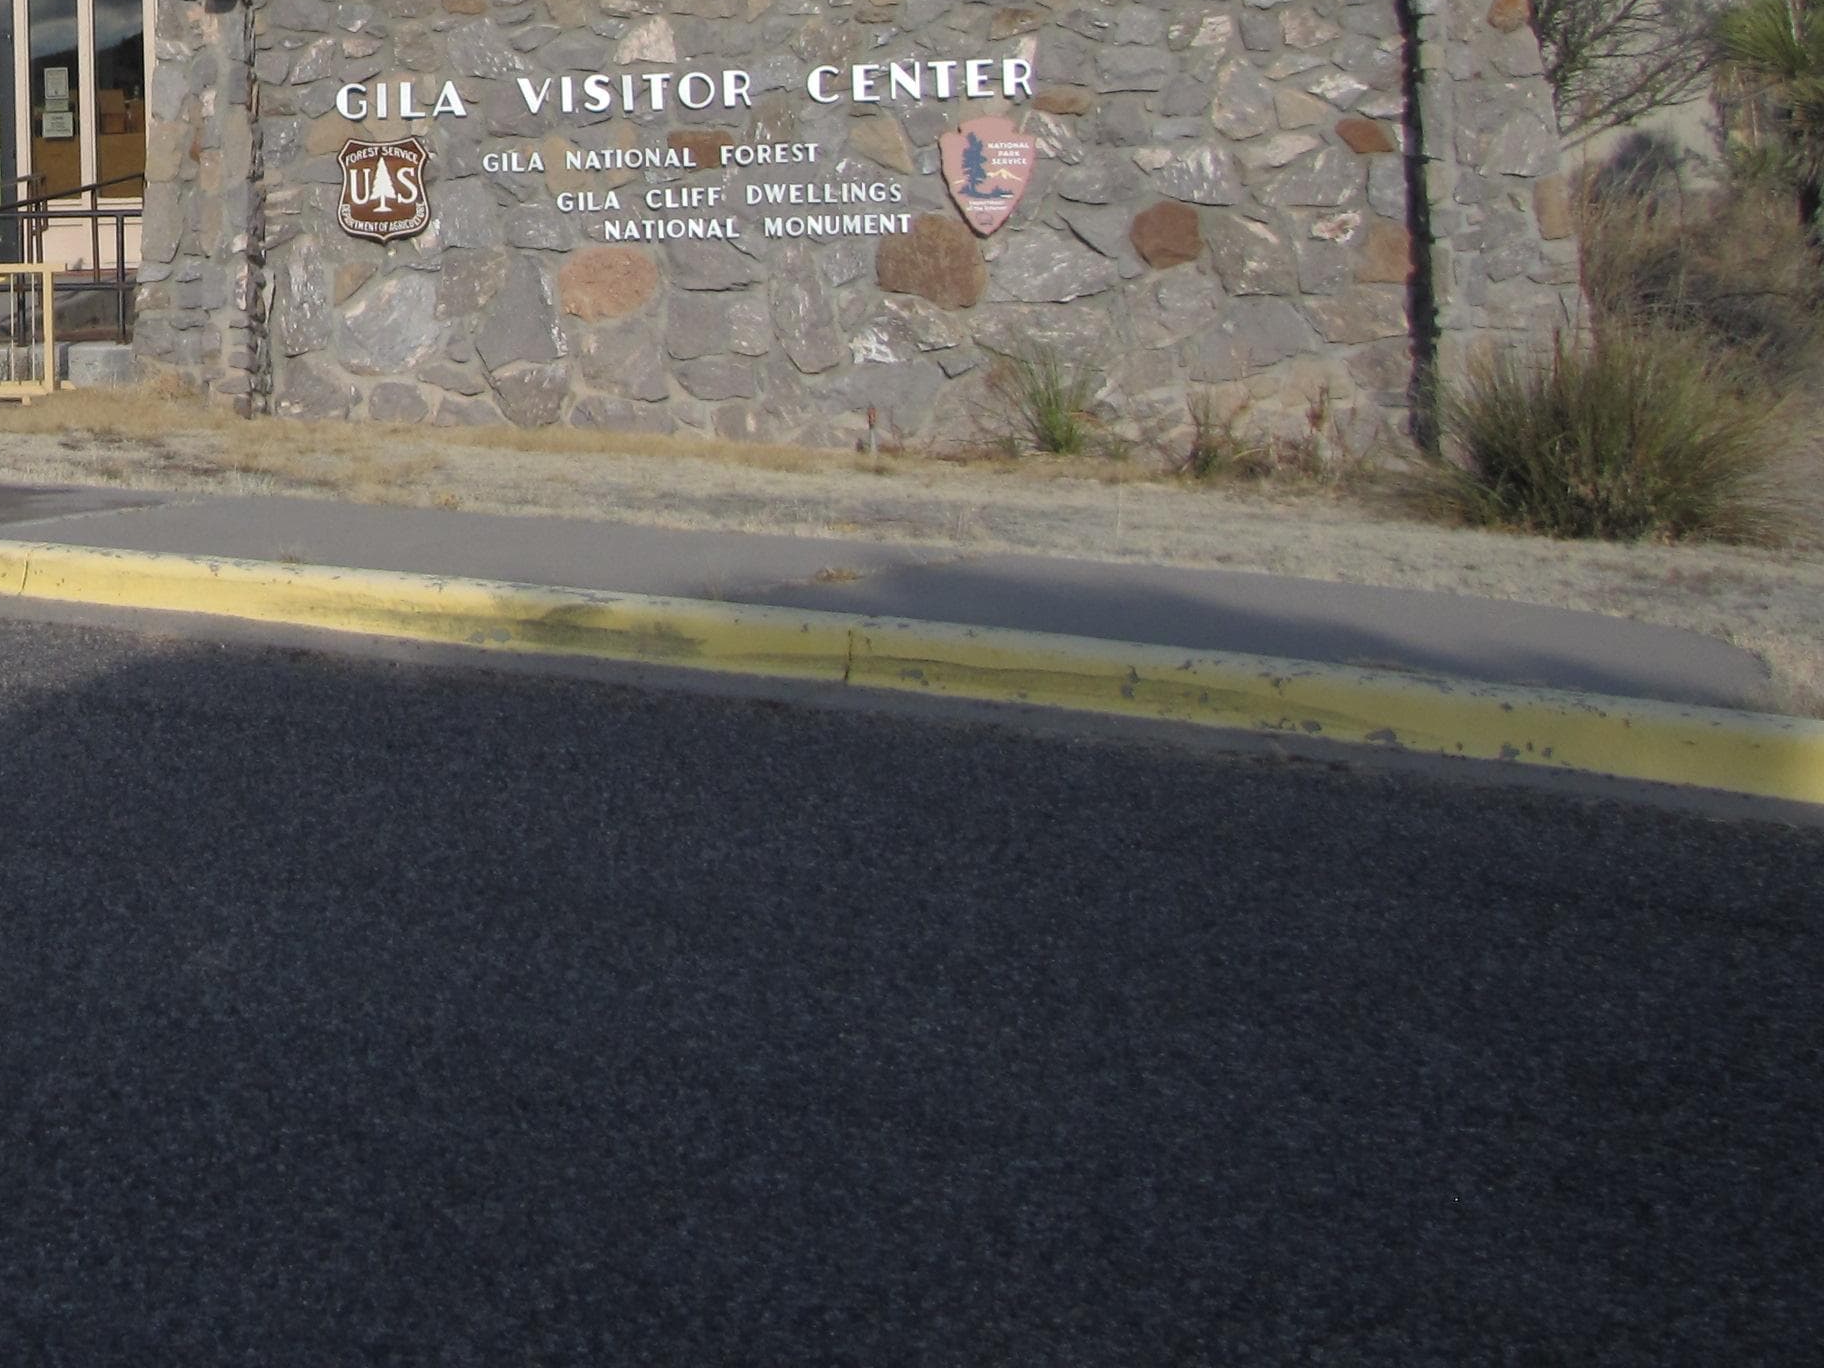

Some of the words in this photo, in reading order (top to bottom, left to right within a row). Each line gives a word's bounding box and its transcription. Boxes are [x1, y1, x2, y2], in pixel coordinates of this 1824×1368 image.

[335, 80, 467, 120] GILA
[516, 69, 752, 115] VISITOR
[806, 58, 1033, 103] CENTER
[345, 146, 378, 166] FOREST
[381, 146, 418, 164] SERVICE
[482, 151, 544, 173] GILA
[566, 147, 697, 170] NATIONAL
[720, 143, 819, 165] FOREST
[991, 157, 1028, 165] SERVICE
[556, 190, 620, 213] GILA
[645, 187, 721, 210] CLIFF
[745, 182, 902, 205] DWELLINGS
[604, 217, 740, 241] NATIONAL
[763, 213, 911, 237] MONUMENT
